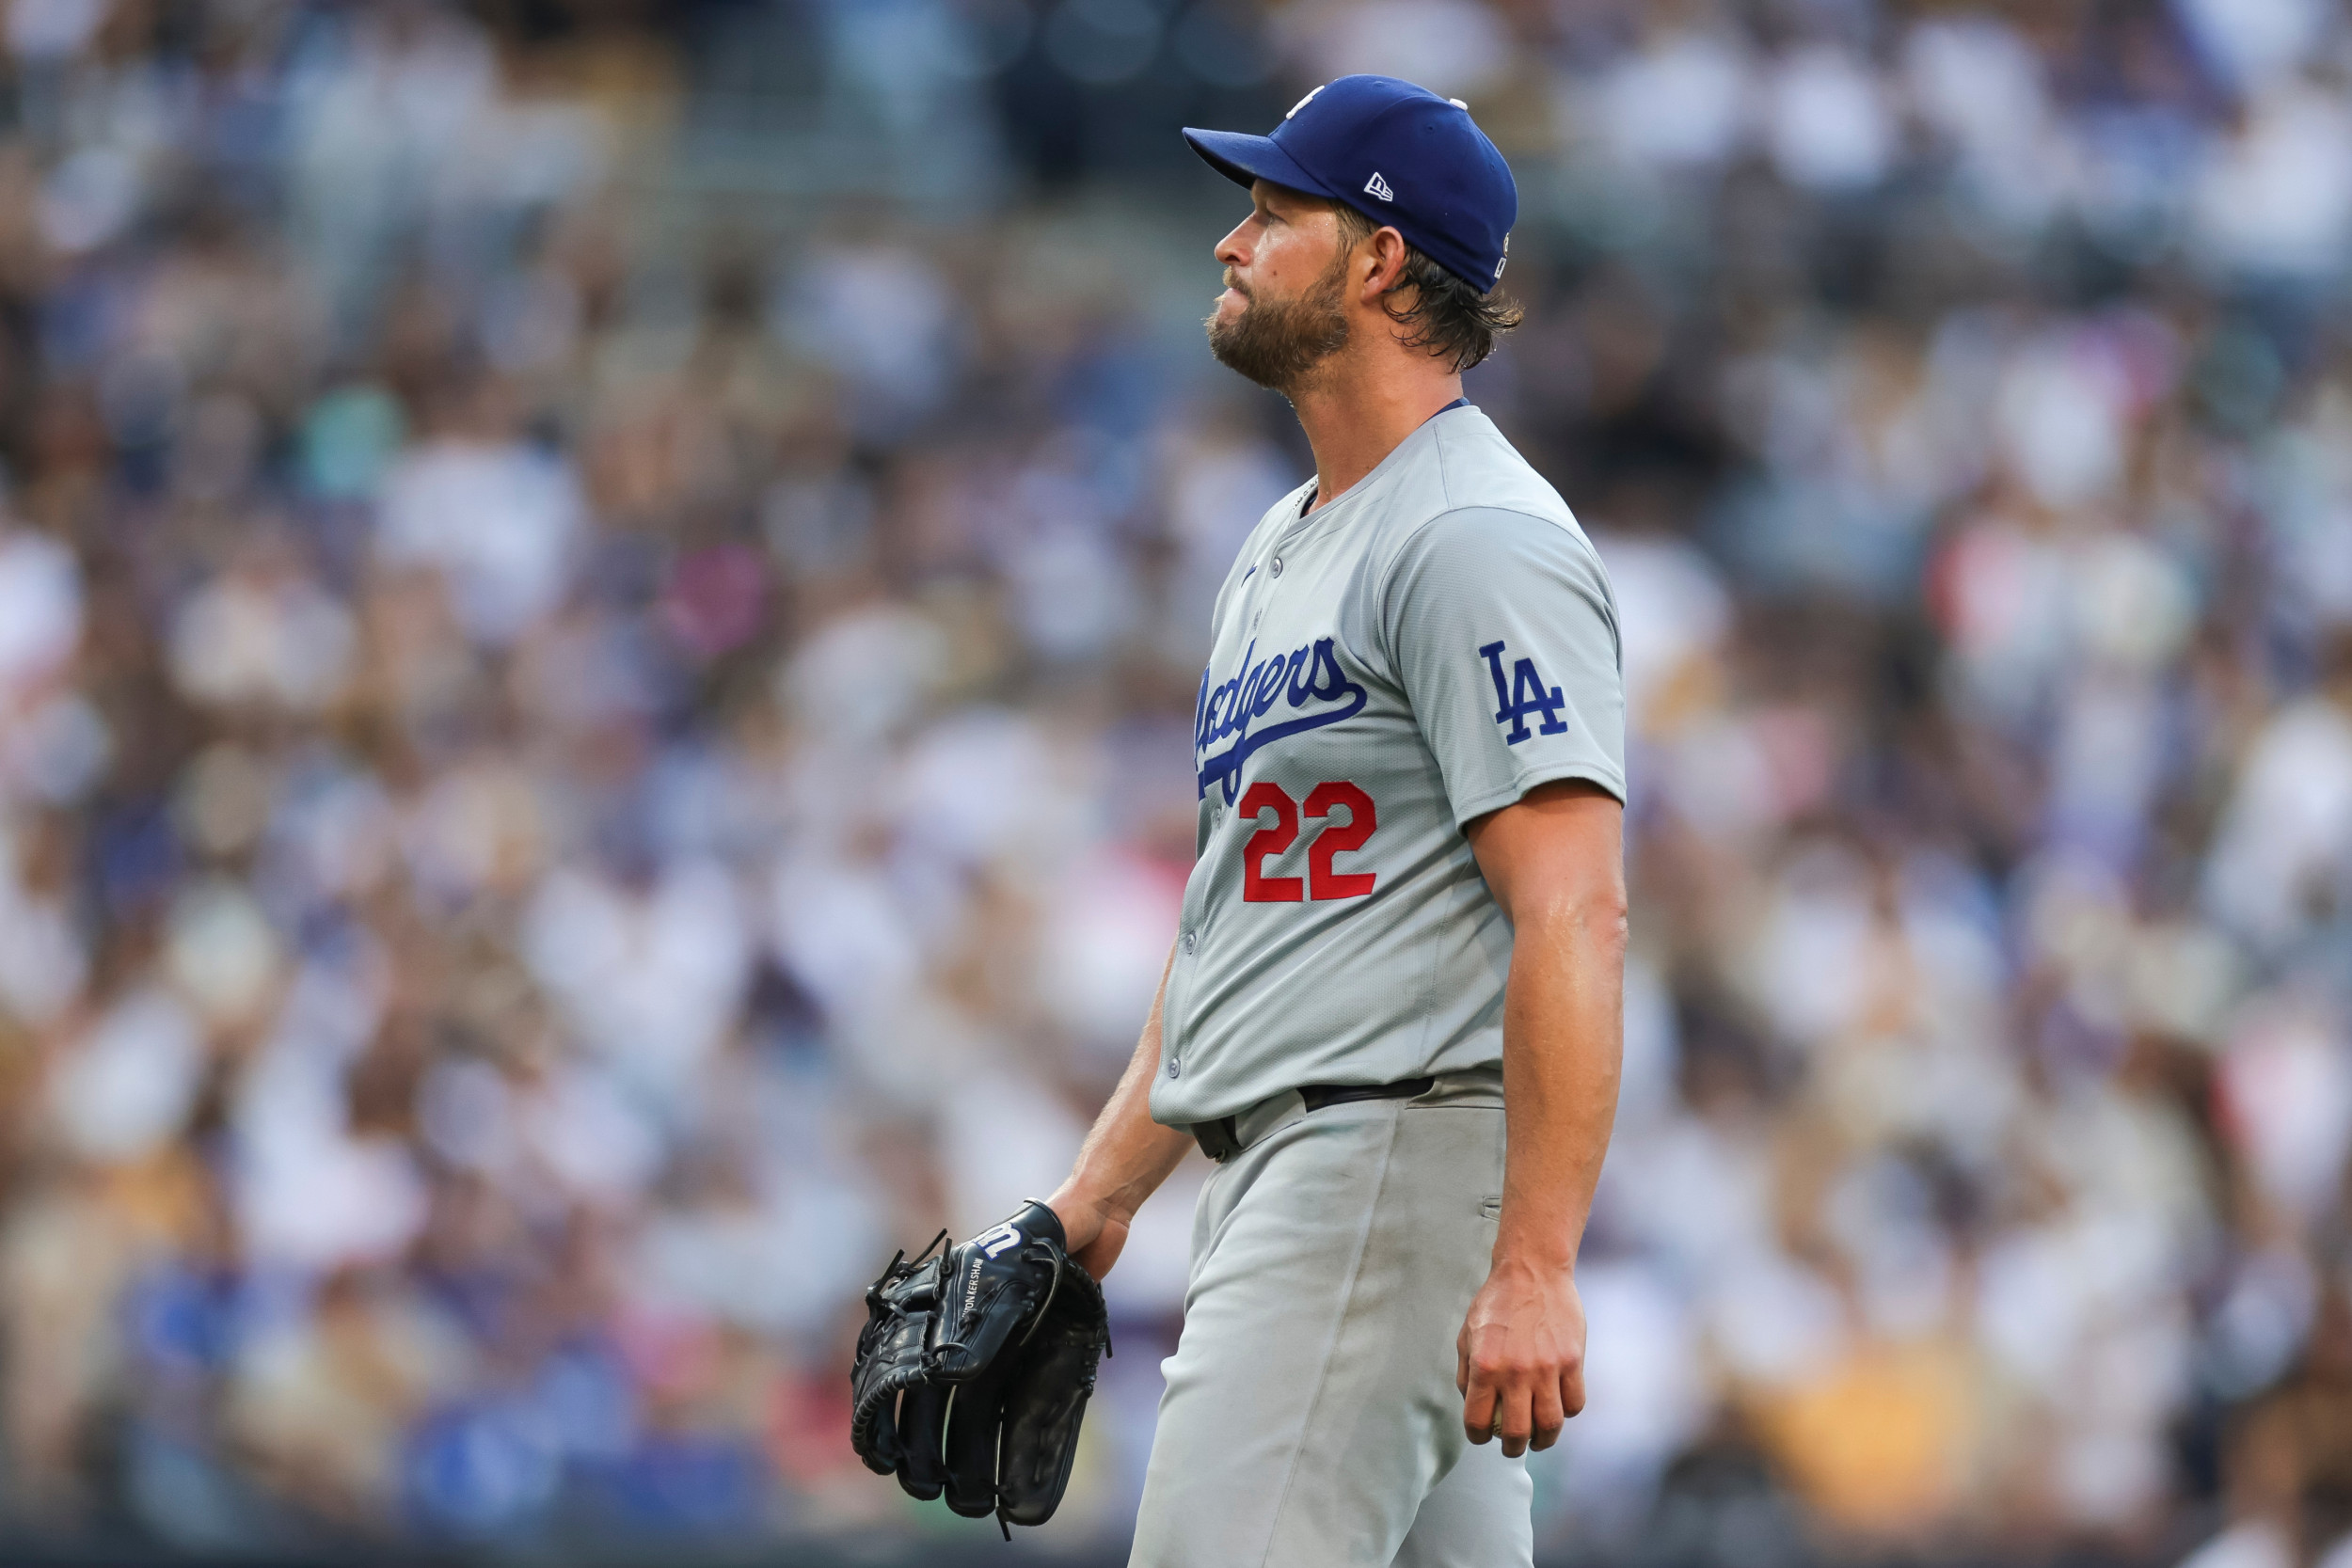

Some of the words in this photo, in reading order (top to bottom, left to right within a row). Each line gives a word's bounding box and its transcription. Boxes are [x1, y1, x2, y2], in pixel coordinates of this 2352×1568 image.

[1478, 640, 1568, 746] LA
[1239, 781, 1377, 902] 22
[966, 1257, 984, 1295] KERSHAW
